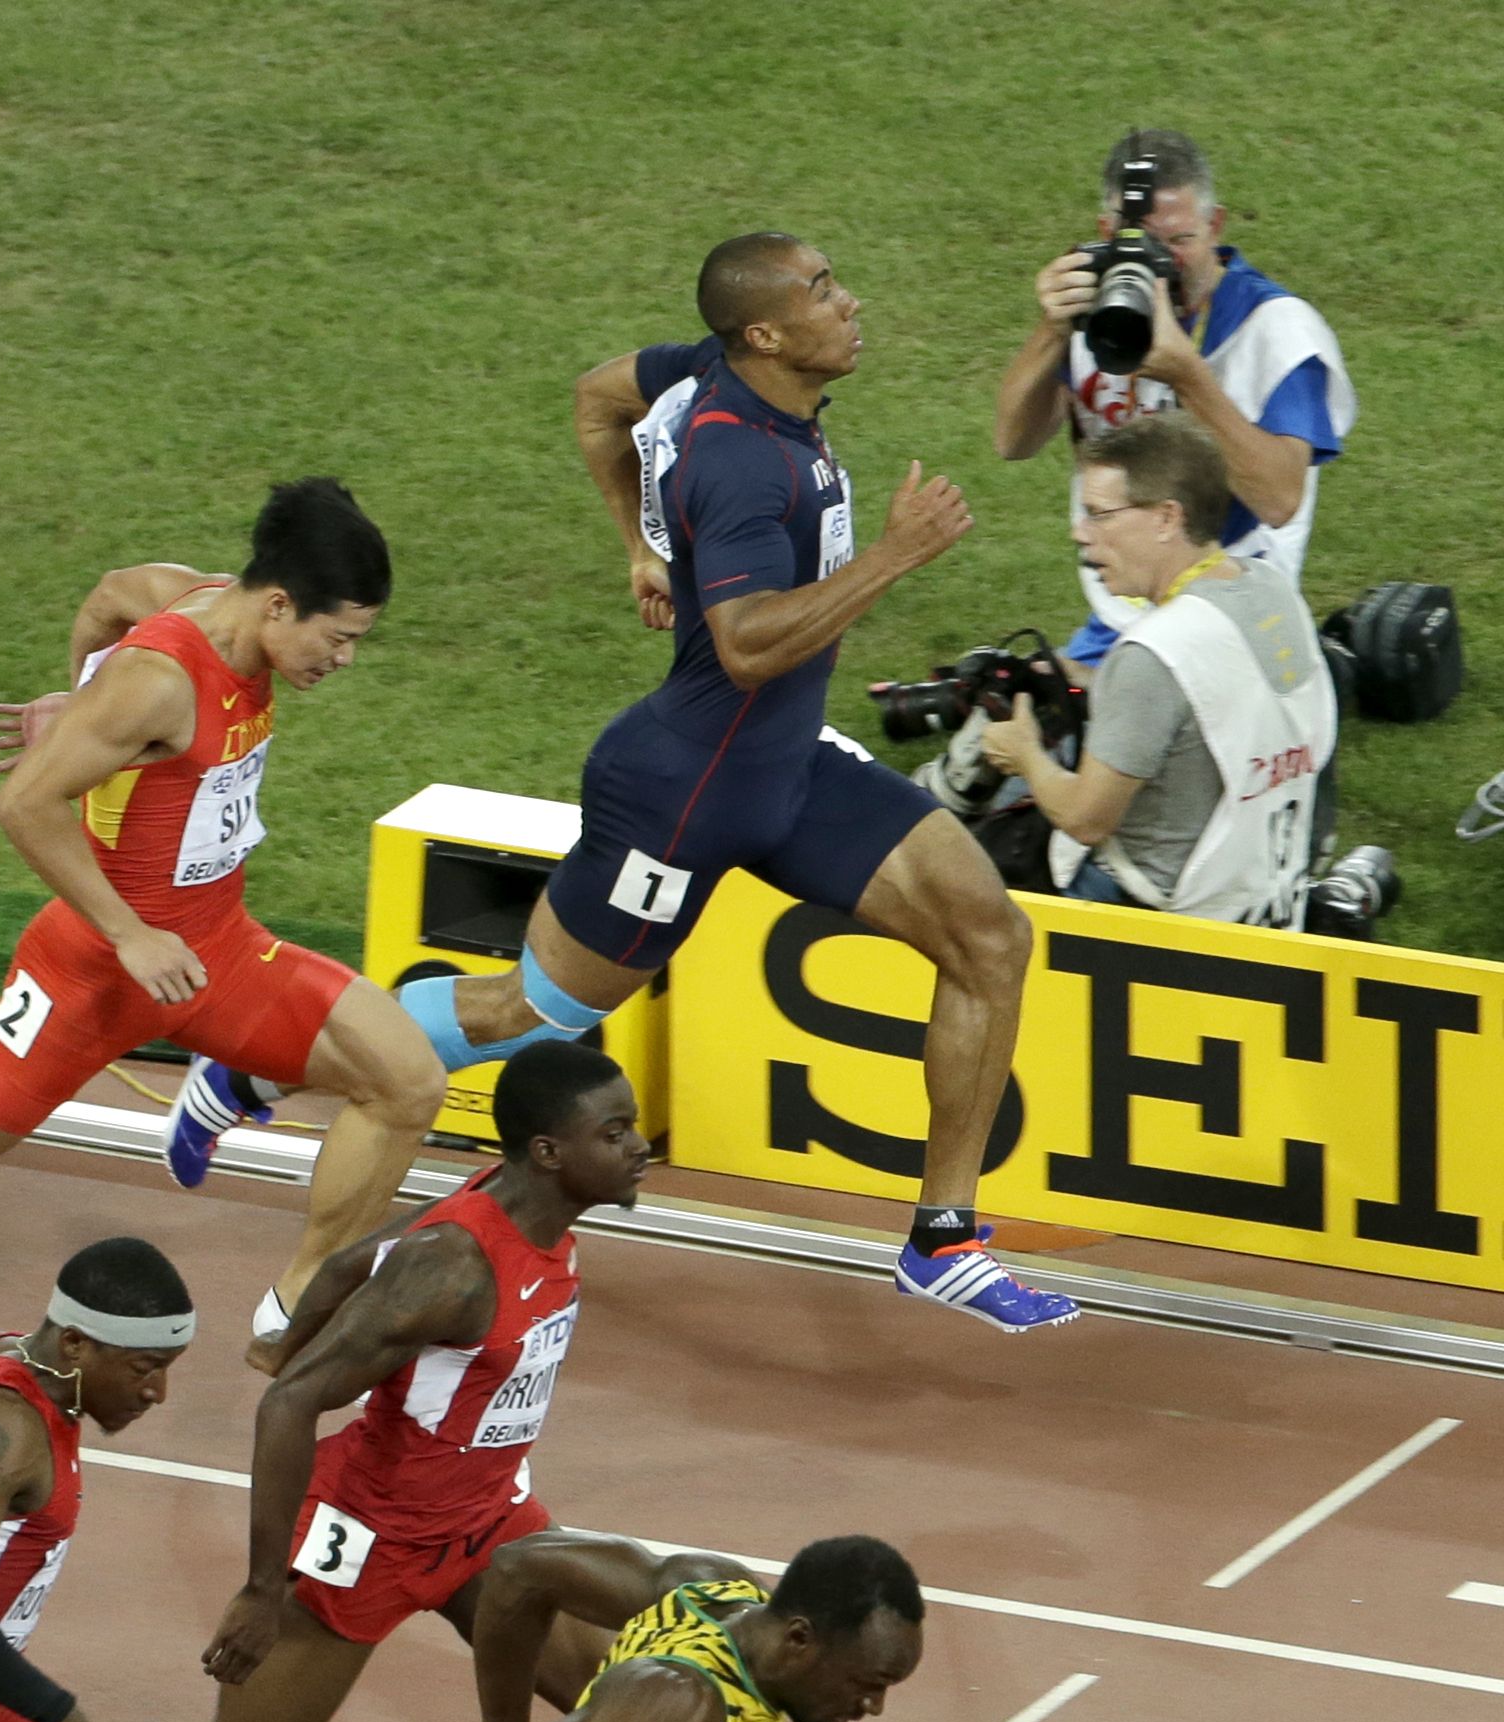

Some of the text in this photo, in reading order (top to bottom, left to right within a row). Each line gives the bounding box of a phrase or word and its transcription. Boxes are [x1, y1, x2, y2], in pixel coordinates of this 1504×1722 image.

[640, 871, 665, 912] 1
[0, 990, 31, 1038] 2
[763, 902, 1480, 1256] SEI
[315, 1523, 347, 1572] 3
